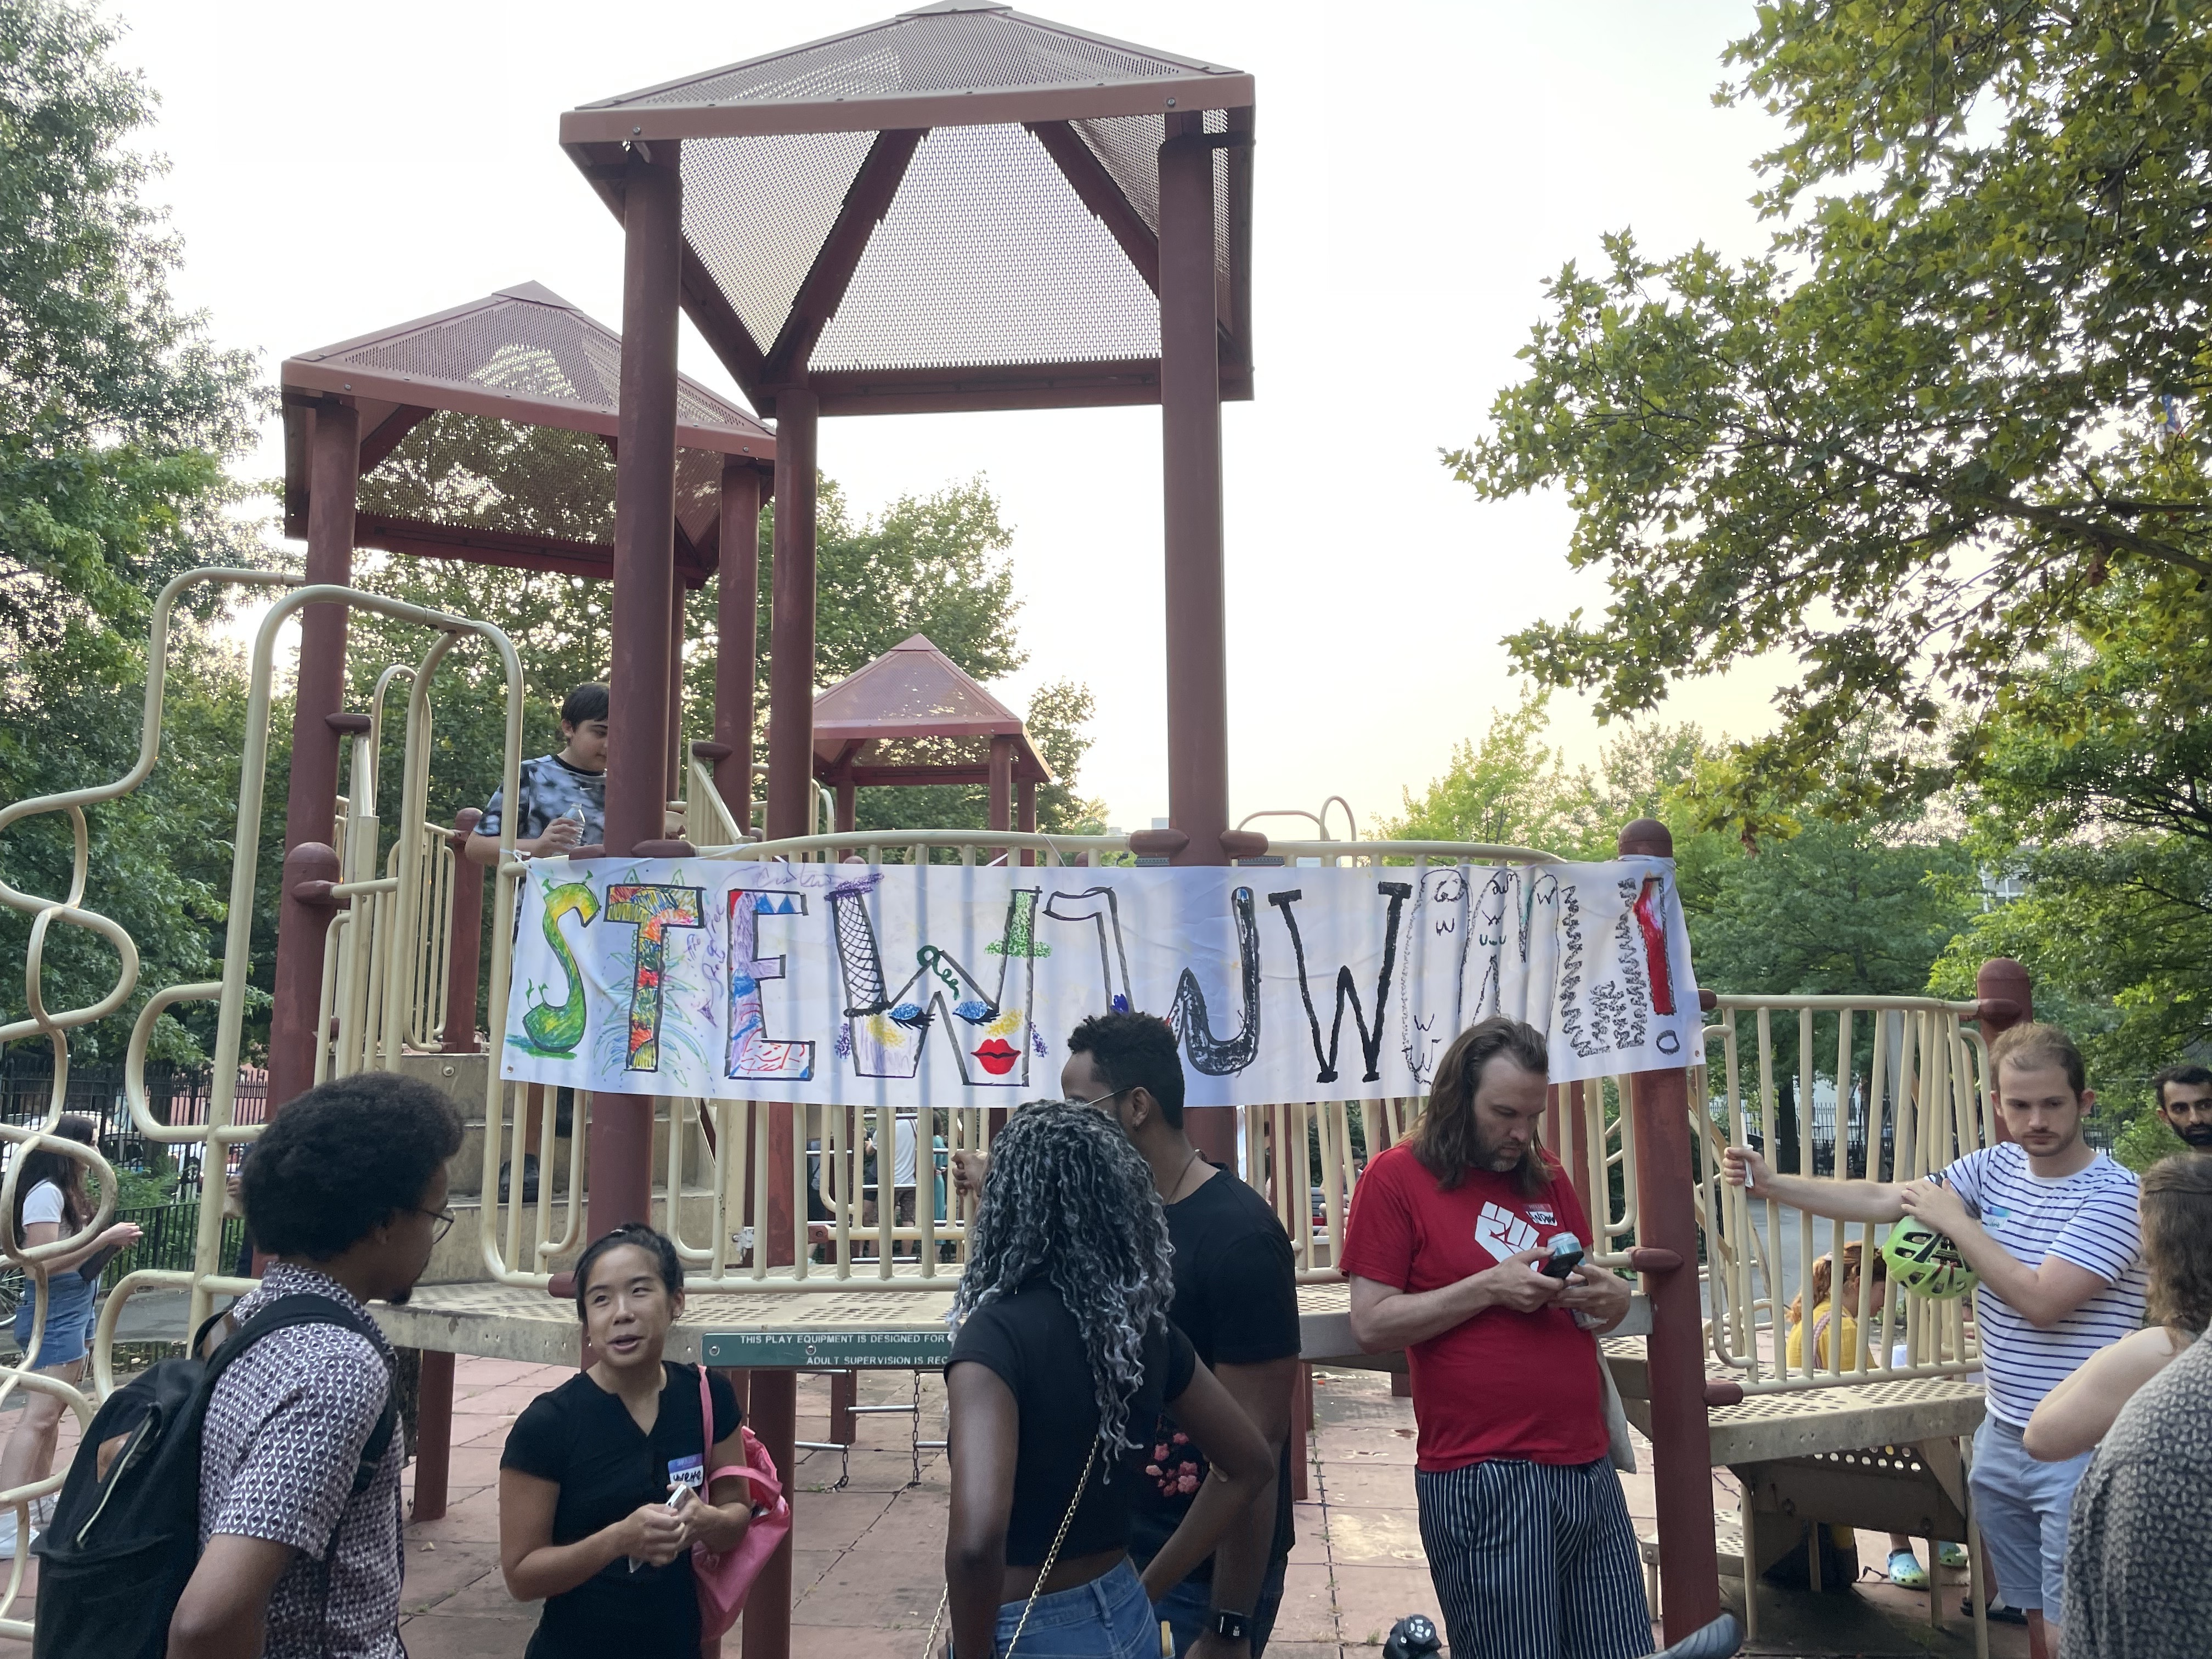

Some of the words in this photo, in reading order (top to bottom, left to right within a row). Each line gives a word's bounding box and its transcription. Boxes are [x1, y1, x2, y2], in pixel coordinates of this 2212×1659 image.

[740, 1335, 762, 1344] THIS
[765, 1335, 793, 1344] PLAY
[797, 1334, 854, 1344] EQUIPMENT
[857, 1334, 867, 1344] IS
[870, 1334, 921, 1344] DESIGNED
[924, 1334, 945, 1343] FOR
[806, 1356, 840, 1365] ADULT
[843, 1356, 911, 1365] SUPERVISION
[913, 1356, 923, 1365] IS
[927, 1356, 949, 1365] REC
